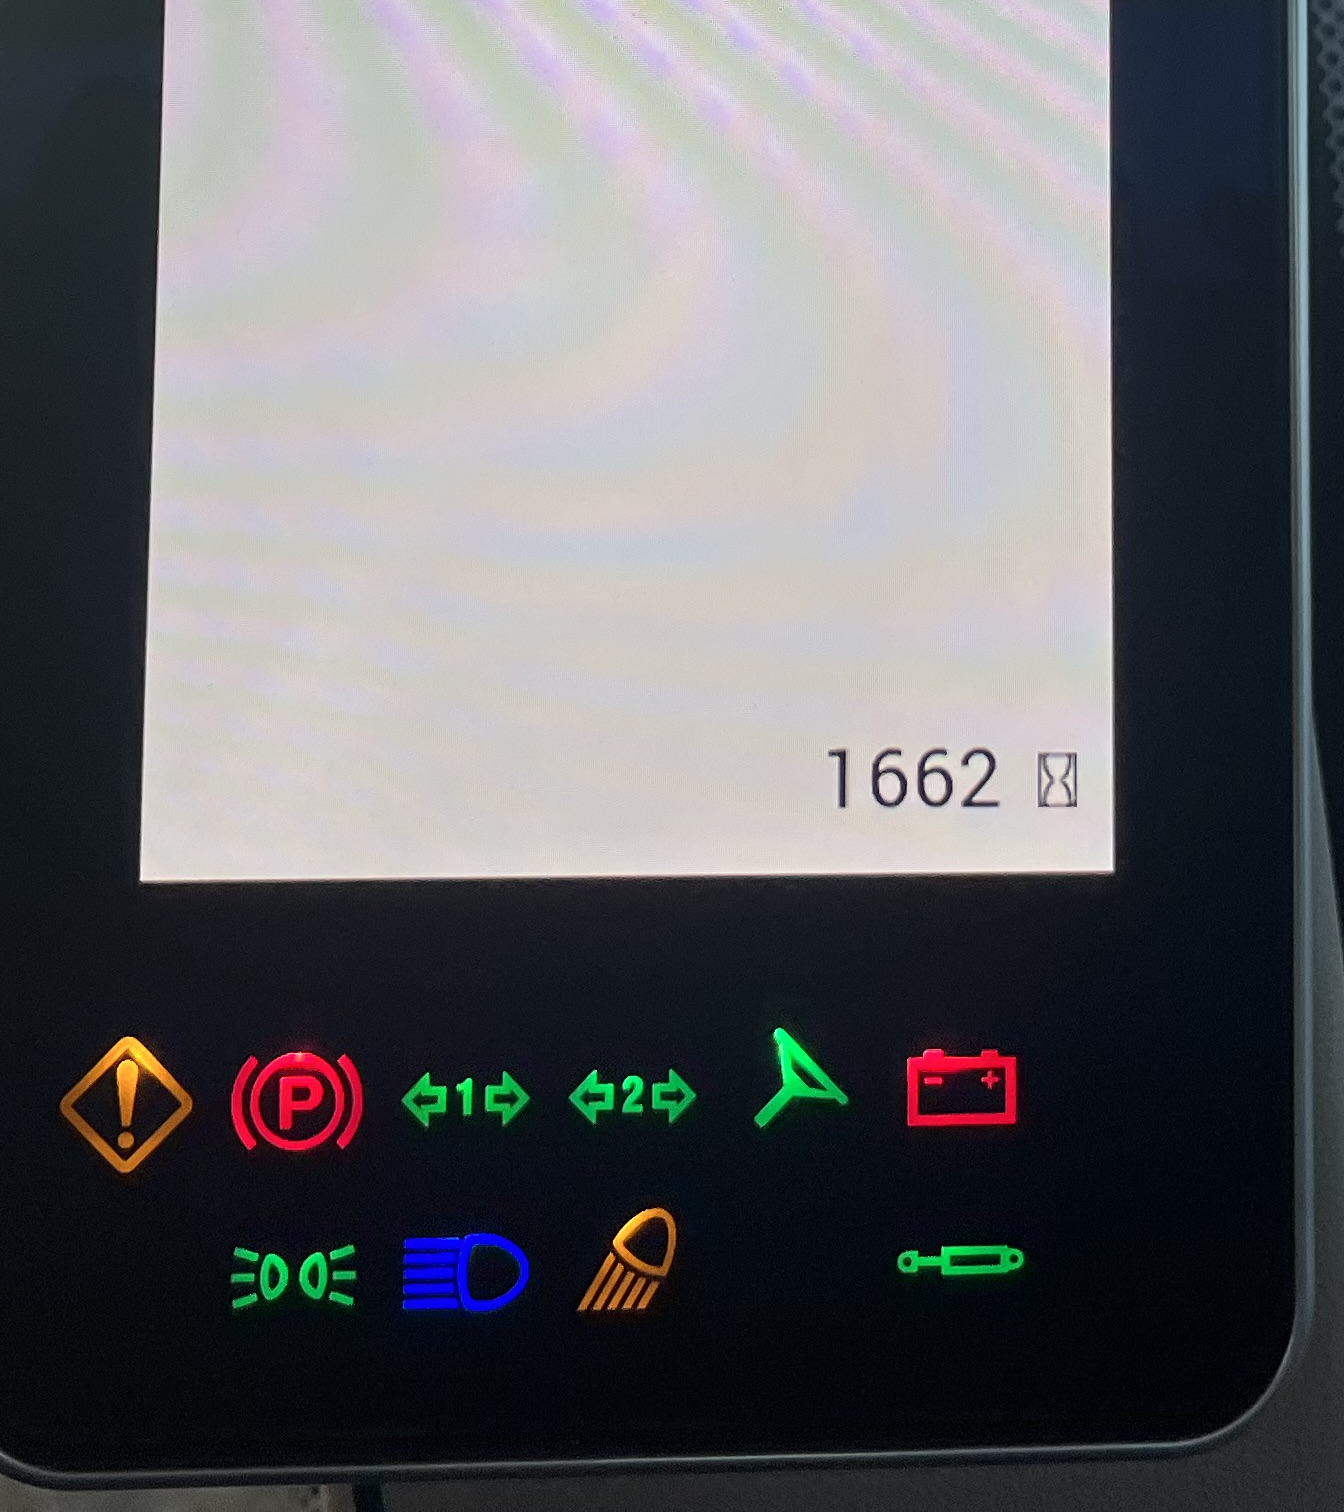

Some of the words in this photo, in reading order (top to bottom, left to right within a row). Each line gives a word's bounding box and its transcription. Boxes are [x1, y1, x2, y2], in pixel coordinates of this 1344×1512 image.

[827, 747, 1000, 809] 1662
[278, 1074, 325, 1130] P
[454, 1076, 474, 1116] 1
[621, 1075, 644, 1114] 2
